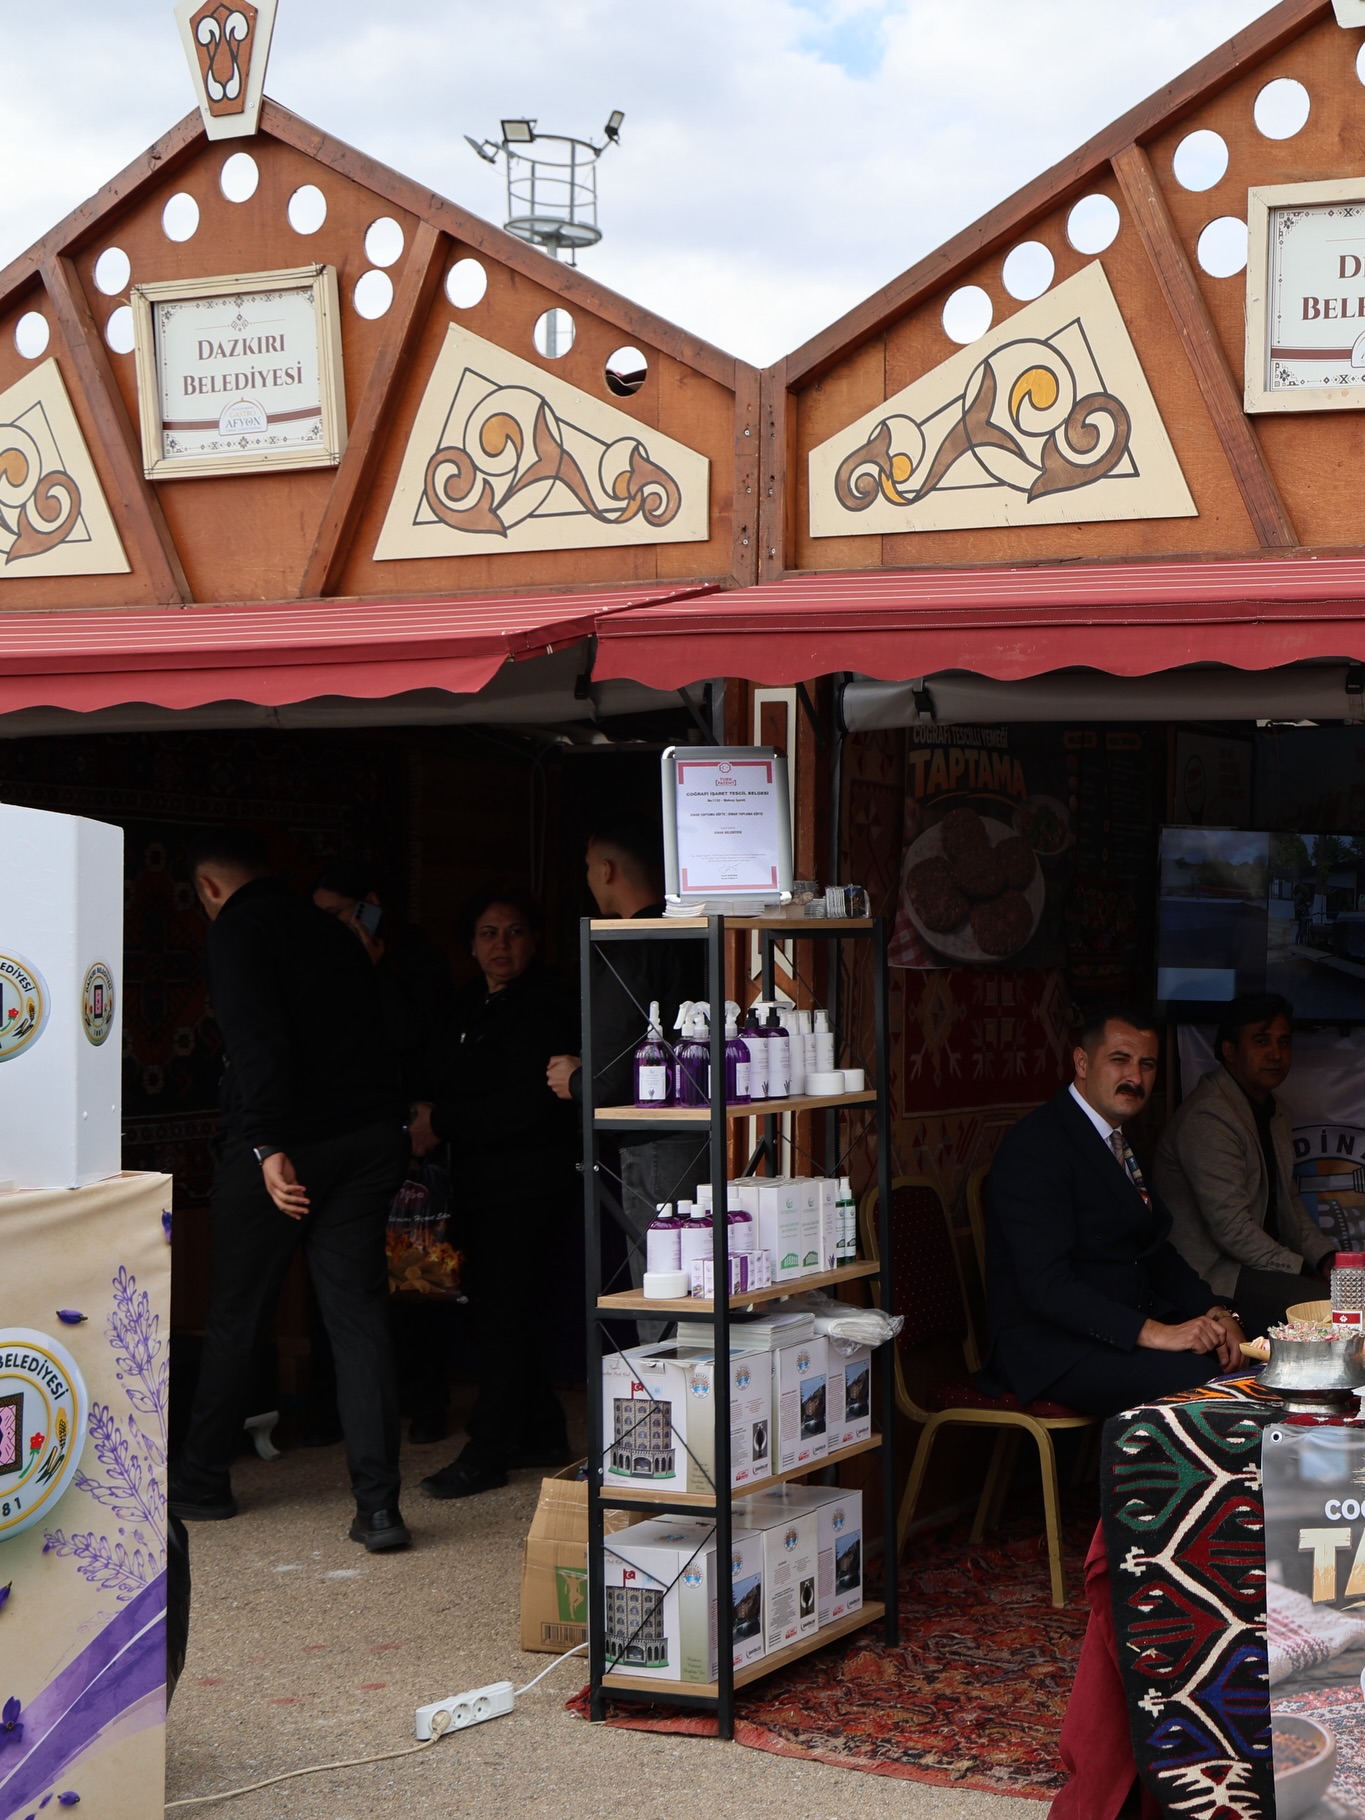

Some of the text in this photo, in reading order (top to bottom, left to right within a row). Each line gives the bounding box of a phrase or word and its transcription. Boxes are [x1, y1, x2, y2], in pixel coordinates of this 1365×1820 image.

[197, 334, 286, 361] DAZKIRI
[183, 361, 303, 396] BELEDİYESİ
[908, 747, 1029, 801] TAPTAMA
[0, 962, 35, 992] EDİYESİ
